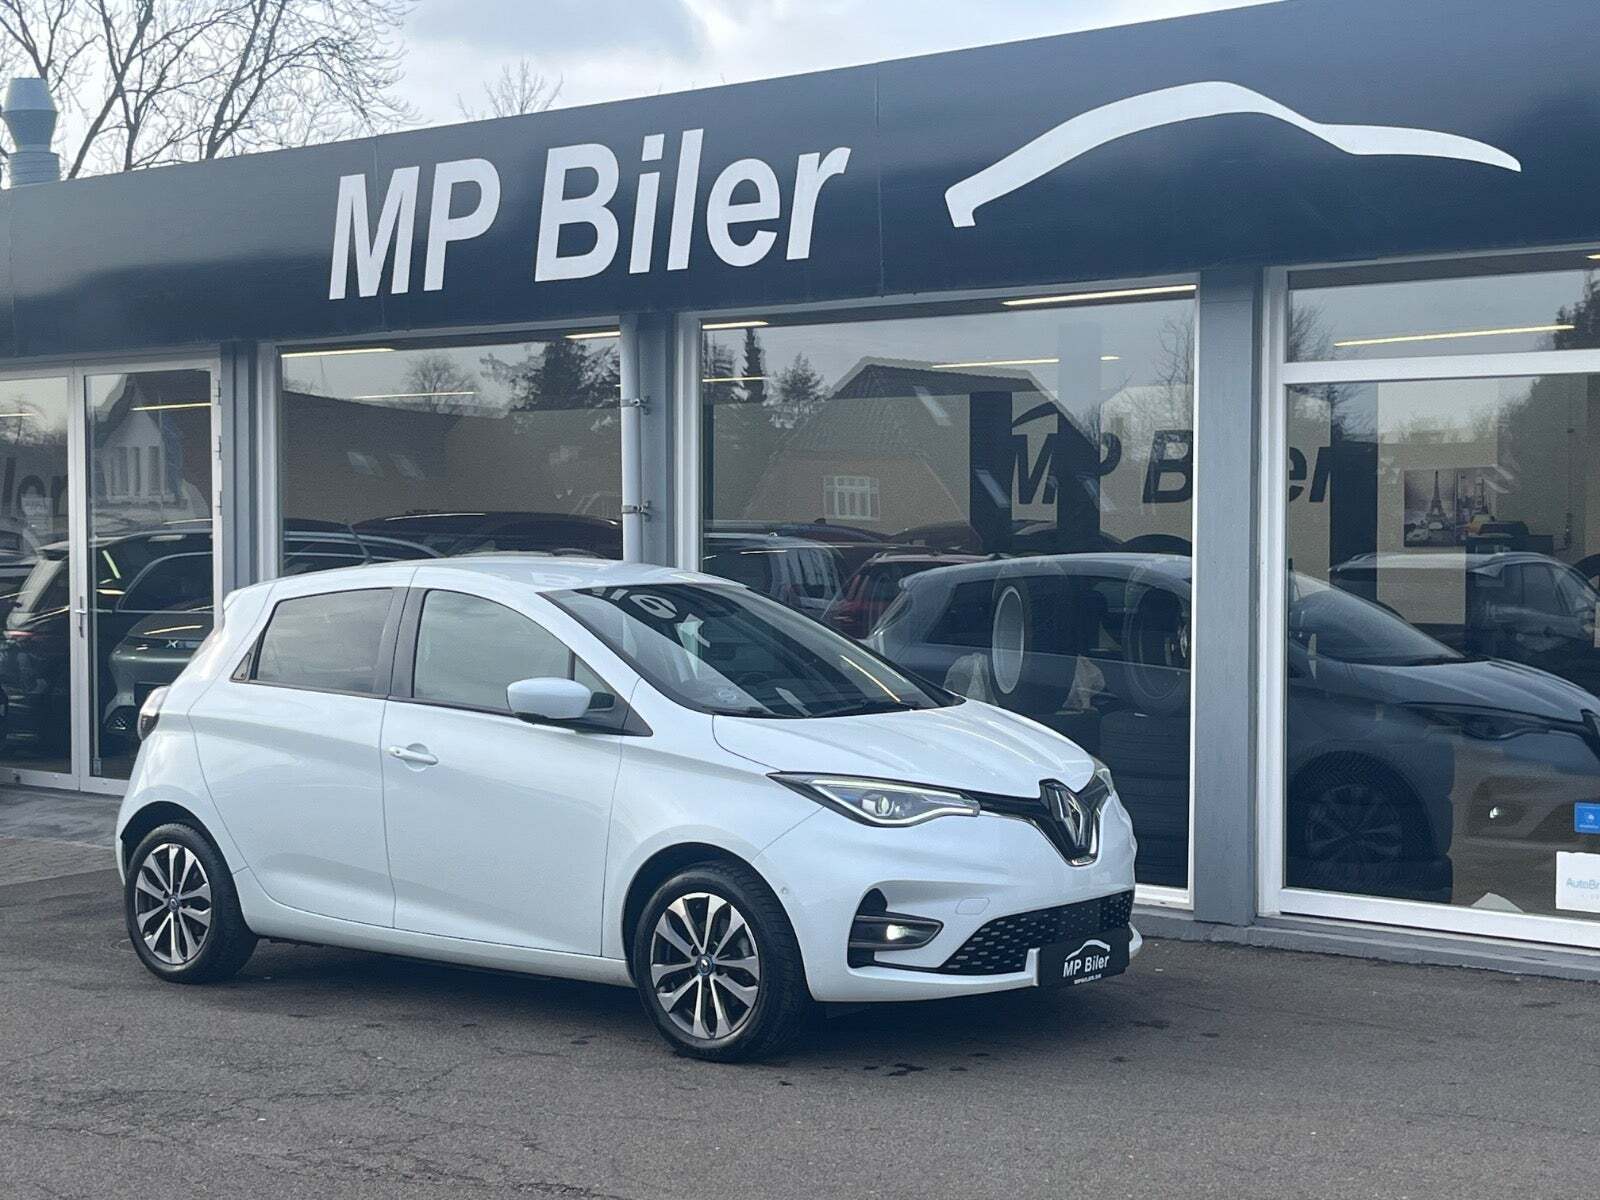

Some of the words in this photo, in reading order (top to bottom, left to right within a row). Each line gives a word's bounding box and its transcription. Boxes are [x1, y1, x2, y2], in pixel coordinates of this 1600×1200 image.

[329, 158, 500, 300] MP
[534, 128, 851, 282] Biler
[1063, 960, 1081, 977] MP
[1084, 955, 1110, 972] Biler
